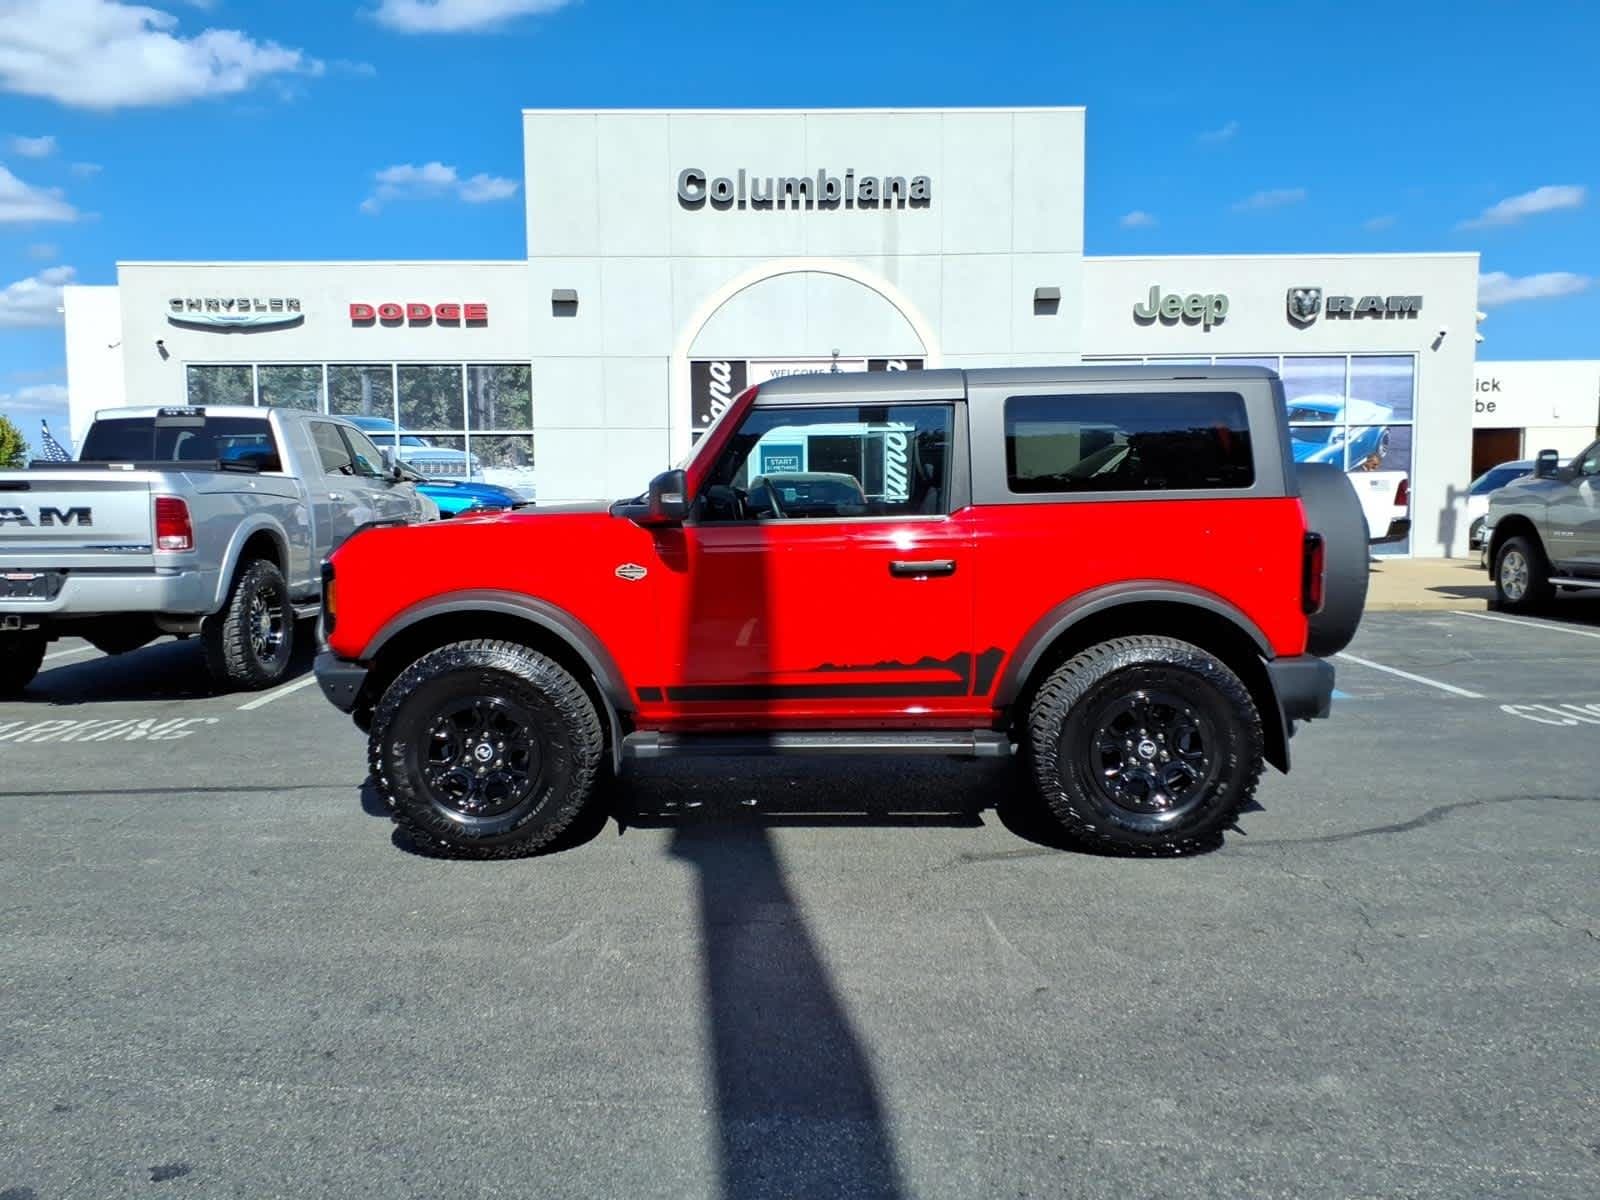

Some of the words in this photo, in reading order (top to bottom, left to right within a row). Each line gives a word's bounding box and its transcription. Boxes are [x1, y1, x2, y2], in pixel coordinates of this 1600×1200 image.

[677, 168, 932, 206] Columbiana
[169, 298, 301, 313] CHRYSLER
[349, 303, 489, 323] DODGE
[1134, 285, 1229, 328] Jeep
[1327, 295, 1423, 317] RAM
[1475, 378, 1501, 393] ick
[1474, 399, 1496, 413] be
[770, 458, 793, 466] START
[1500, 703, 1600, 726] CU
